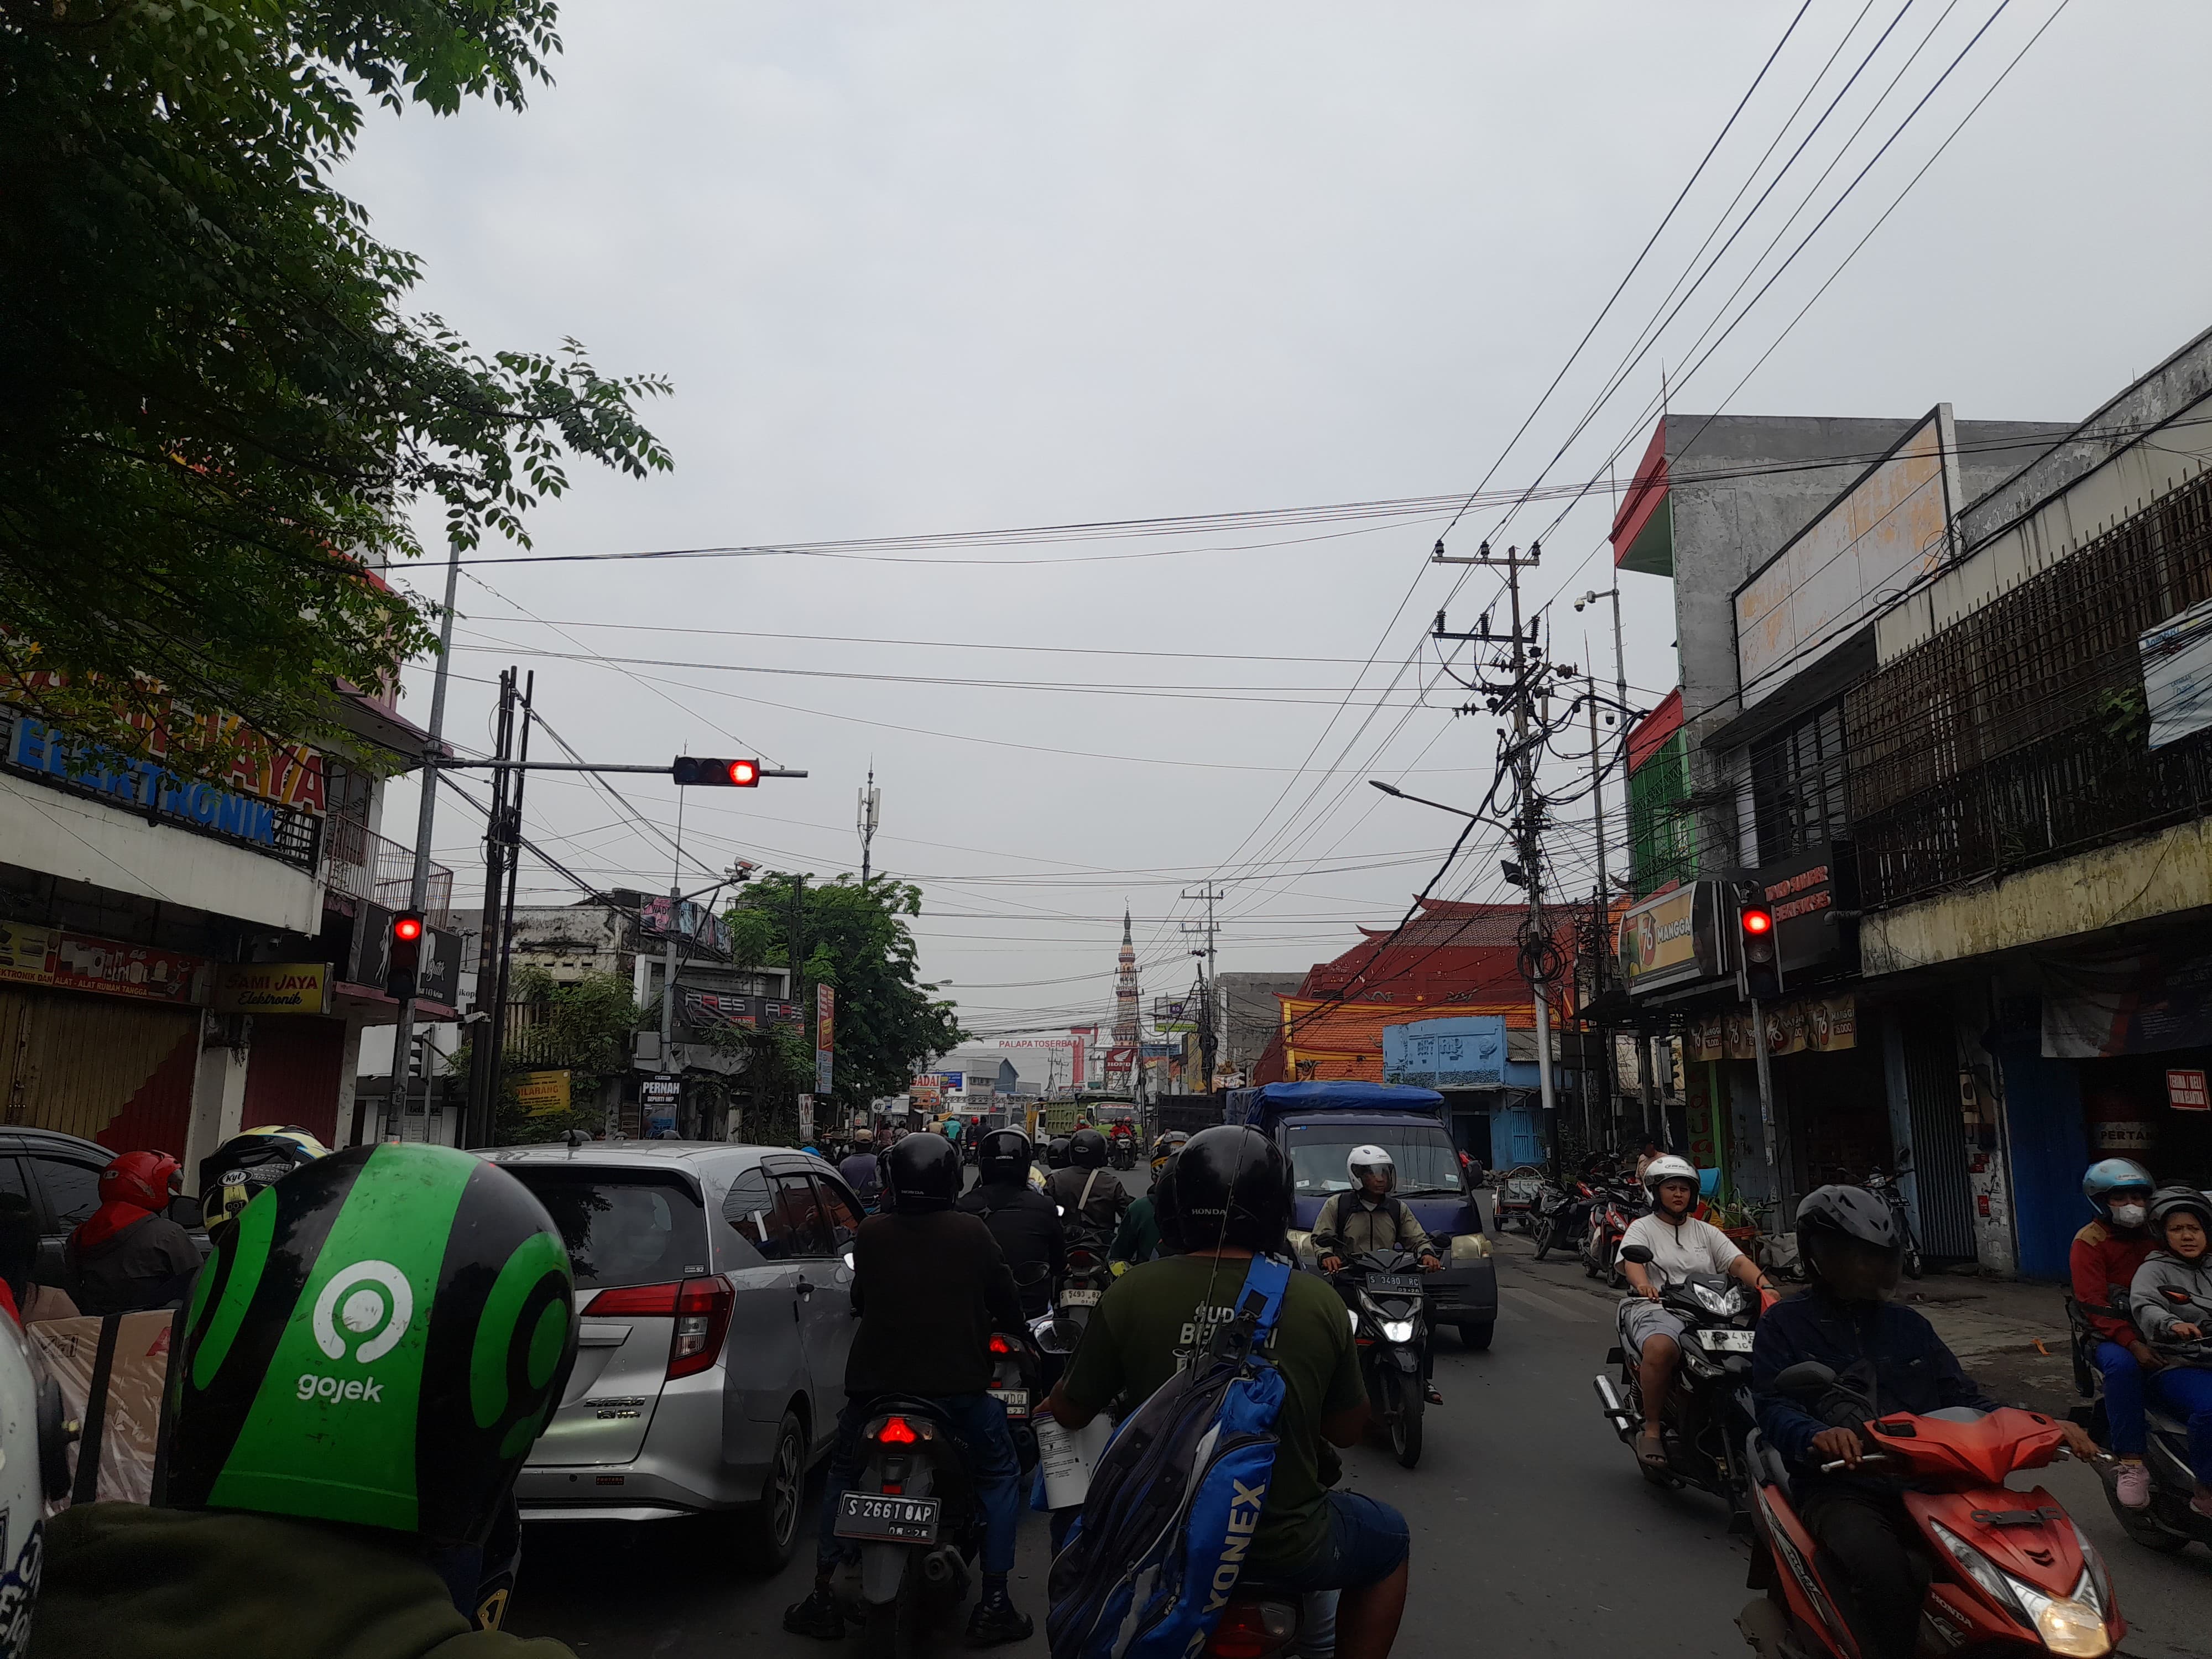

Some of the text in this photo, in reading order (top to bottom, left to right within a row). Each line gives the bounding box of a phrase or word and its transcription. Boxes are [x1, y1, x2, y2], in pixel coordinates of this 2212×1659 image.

[1656, 916, 1692, 945] MANGGA
[38, 974, 53, 983] DAN
[55, 977, 73, 987] ALAT
[79, 978, 96, 989] ALAT
[122, 985, 148, 995] TANGGA
[275, 974, 318, 991] JAYA
[238, 990, 303, 1005] Elektronik
[1034, 1040, 1073, 1048] TOSERBA
[642, 1081, 681, 1094] PERNAH
[911, 1074, 939, 1087] GADAI
[227, 1201, 244, 1211] DOT
[1191, 1208, 1227, 1216] HONDA
[296, 1373, 385, 1404] gojek
[848, 1499, 858, 1516] S
[862, 1500, 901, 1520] 2661
[1202, 1477, 1266, 1614] YONEX
[1931, 1591, 1974, 1630] HONDA
